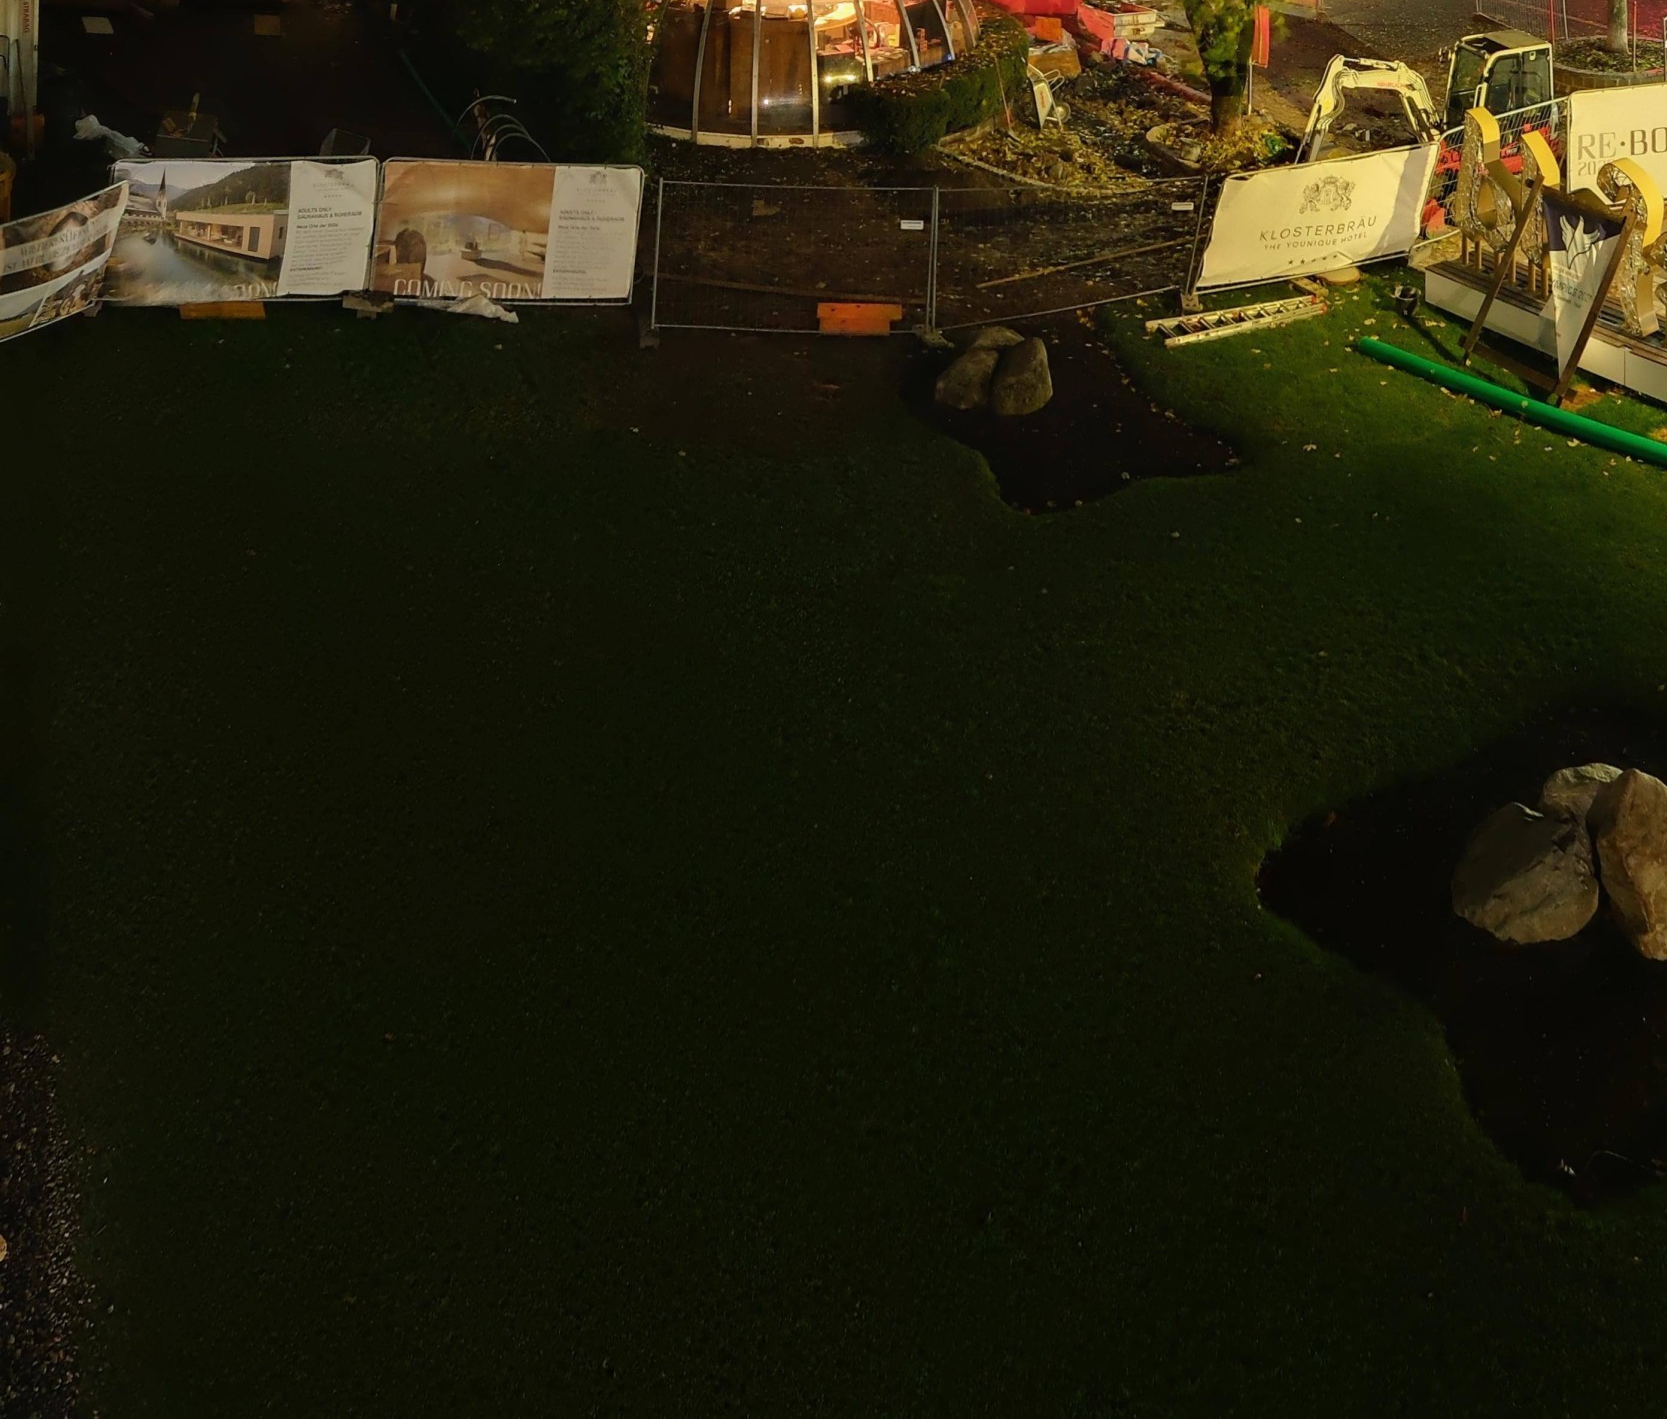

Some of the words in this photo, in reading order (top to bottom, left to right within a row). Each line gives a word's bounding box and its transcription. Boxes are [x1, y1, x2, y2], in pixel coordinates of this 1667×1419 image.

[1259, 216, 1377, 242] KLOSTERBRÄU
[1264, 242, 1282, 251] THE
[1286, 238, 1338, 249] YOUNIQUE
[1341, 232, 1368, 244] HOTEL
